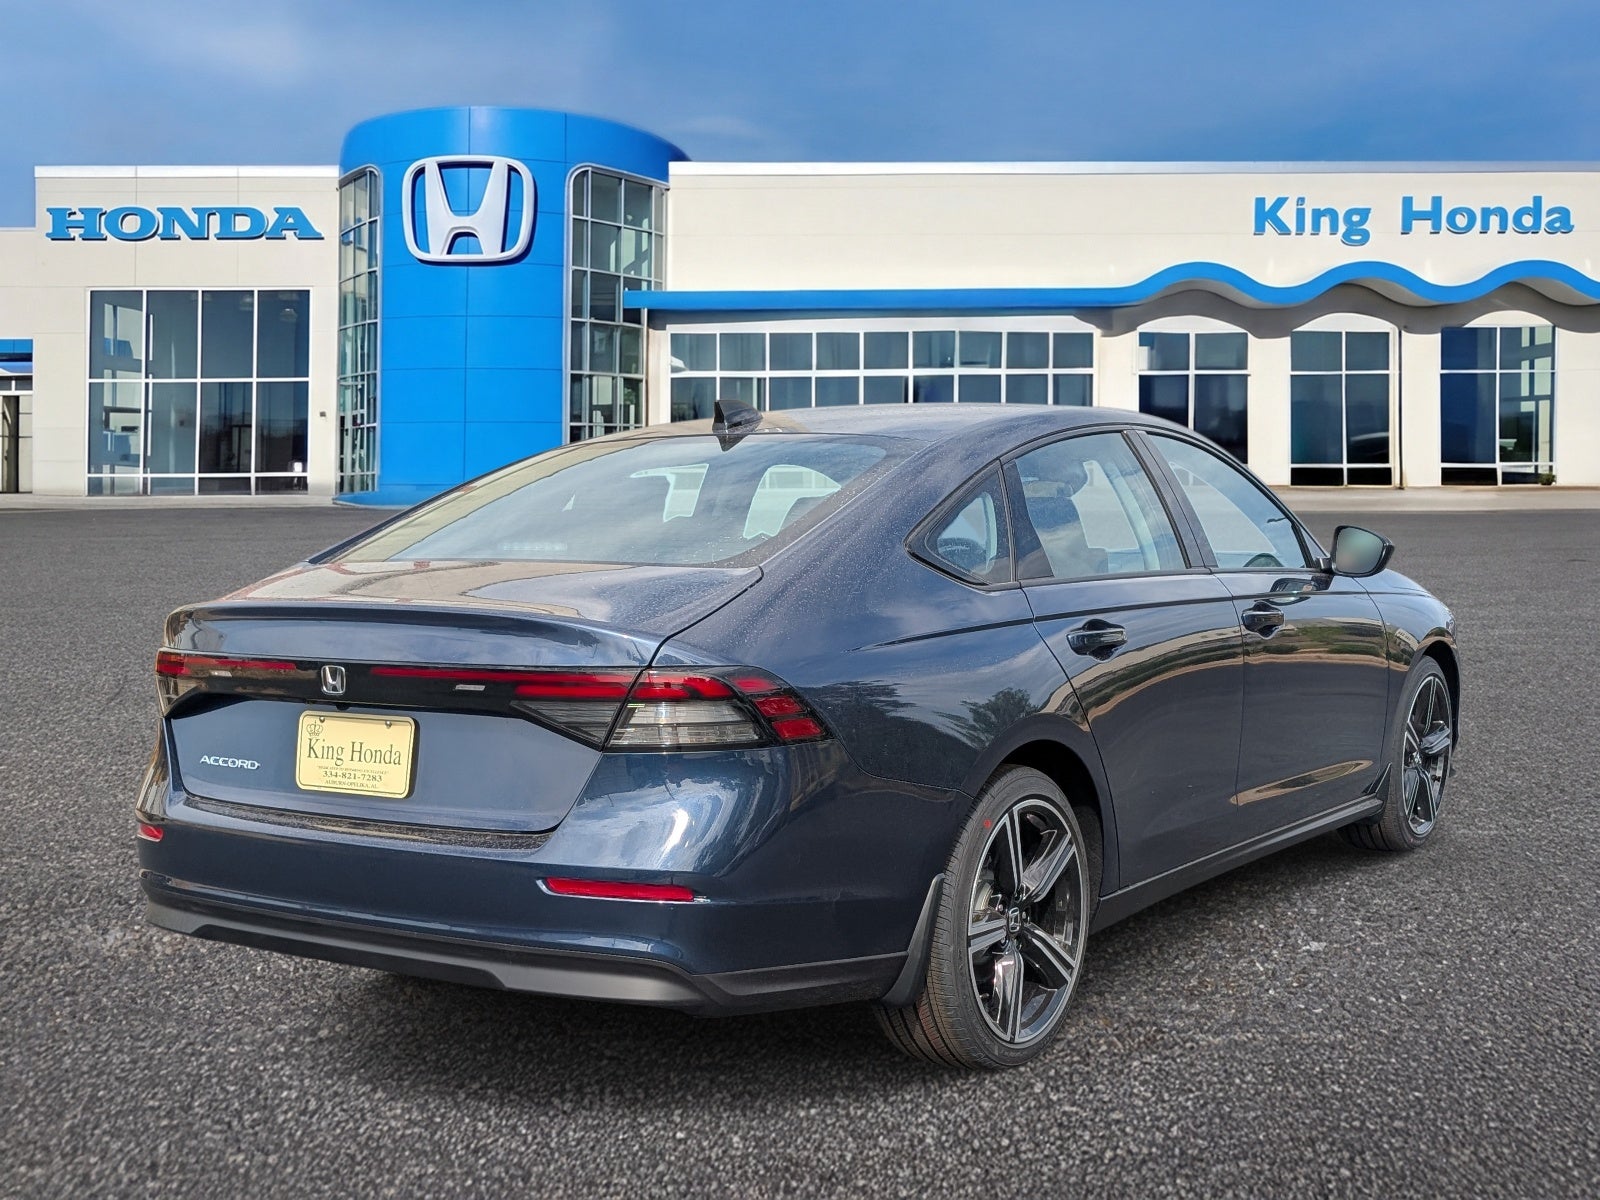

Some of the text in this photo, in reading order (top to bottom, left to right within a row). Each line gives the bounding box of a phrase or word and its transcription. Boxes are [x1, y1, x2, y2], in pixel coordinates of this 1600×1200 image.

[45, 206, 324, 241] HONDA
[1253, 195, 1575, 246] King Honda
[199, 755, 260, 769] ACCORD
[307, 737, 402, 766] King Honda
[322, 770, 383, 782] 334-821-7283
